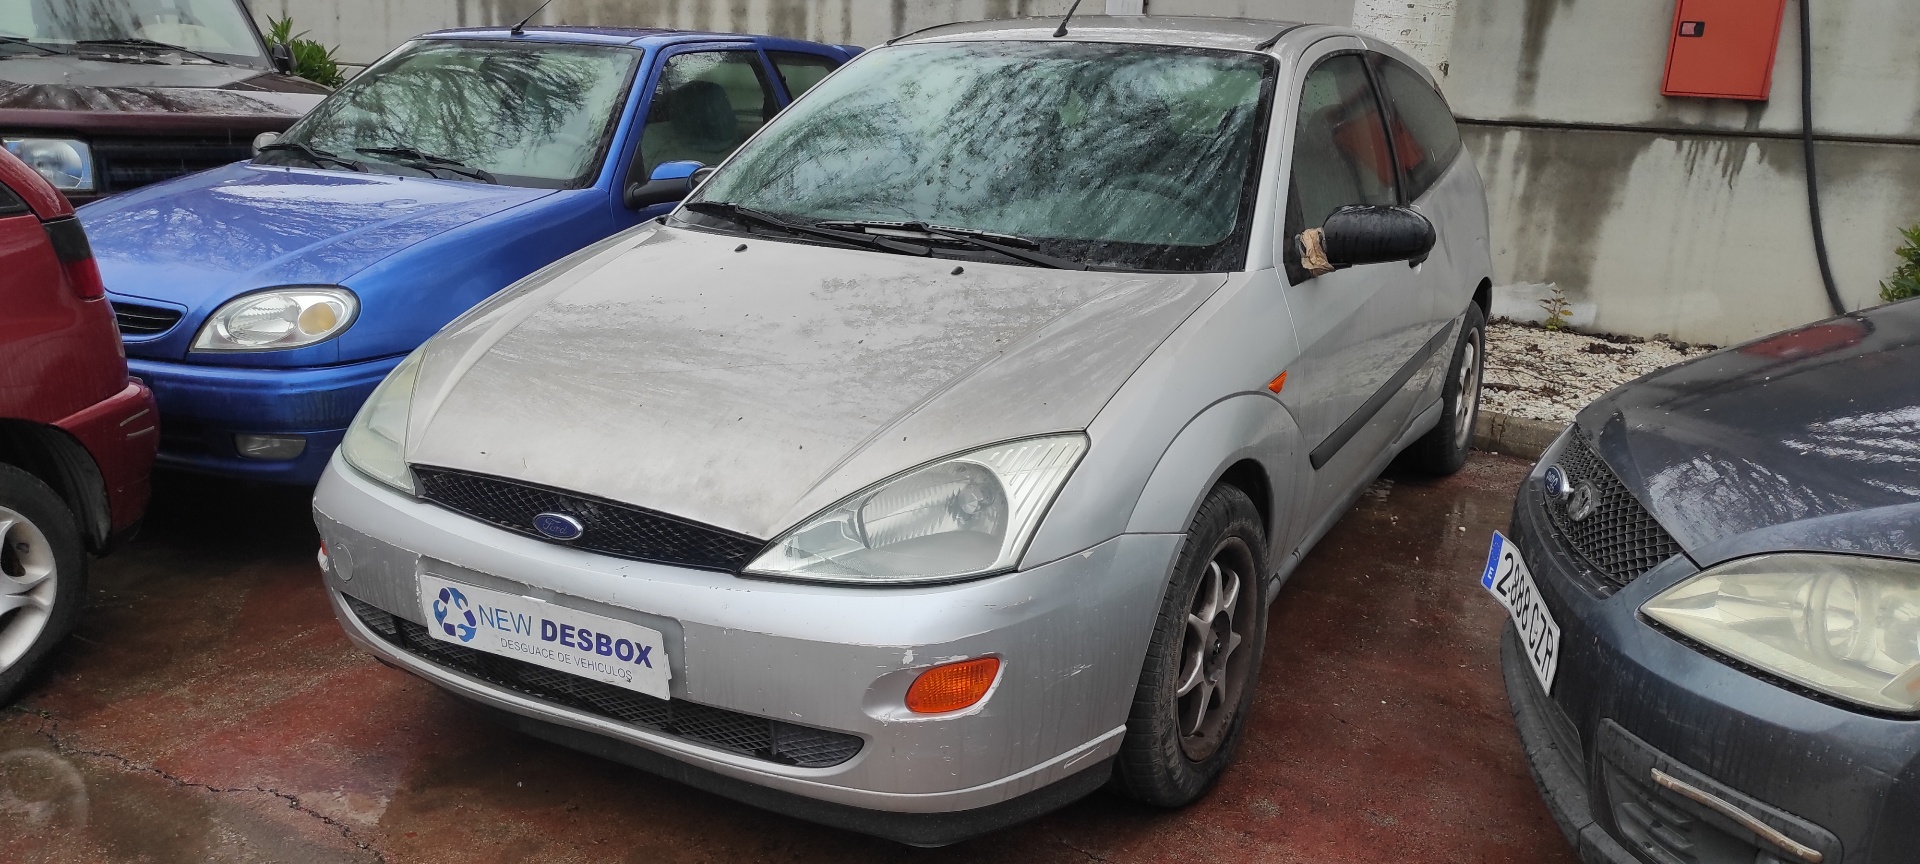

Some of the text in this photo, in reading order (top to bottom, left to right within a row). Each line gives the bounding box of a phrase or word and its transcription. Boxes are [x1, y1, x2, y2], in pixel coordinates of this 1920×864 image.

[542, 517, 568, 535] Ford
[1496, 552, 1531, 631] 2888
[478, 604, 653, 669] NEW DESBOX
[500, 637, 633, 681] DESGUACE DE VEHICULOS
